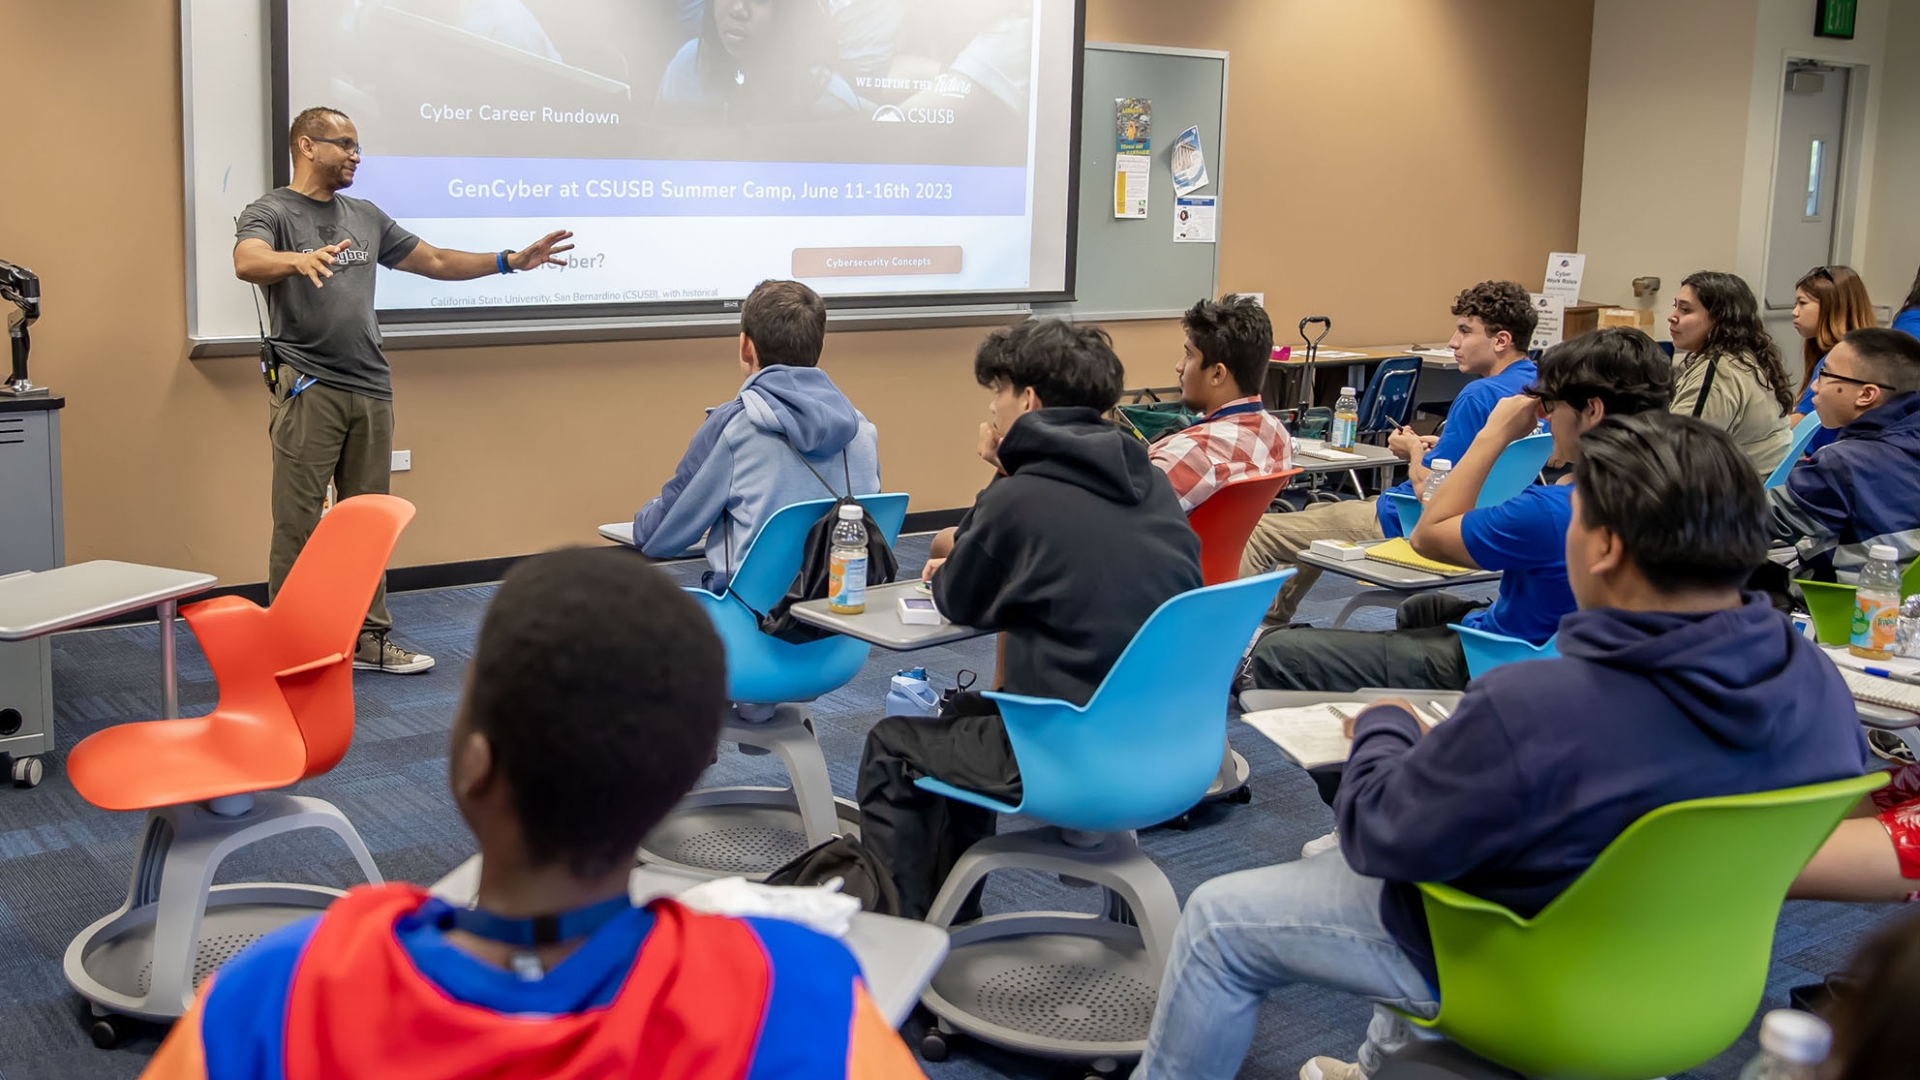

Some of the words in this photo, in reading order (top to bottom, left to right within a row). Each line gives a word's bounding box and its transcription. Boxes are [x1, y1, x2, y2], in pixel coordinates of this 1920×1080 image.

[856, 77, 872, 87] WE
[874, 78, 910, 89] DEFINE
[913, 79, 932, 90] THE
[420, 103, 472, 123] Cyber
[479, 105, 536, 122] Career
[542, 107, 619, 124] Rundown
[908, 108, 954, 124] CSUSB
[448, 179, 553, 201] GenCyber
[559, 180, 579, 198] at
[585, 180, 654, 198] CSUSB
[661, 180, 737, 199] Summer
[743, 181, 796, 201] Camp,
[801, 182, 839, 199] June
[845, 183, 910, 199] 11-16th
[915, 183, 953, 200] 2023
[826, 257, 889, 269] Cybersecurity
[892, 256, 931, 268] Concepts
[431, 297, 476, 307] California
[478, 295, 502, 305] State
[554, 292, 572, 303] San
[573, 290, 620, 302] Bernardino
[662, 288, 681, 299] with
[682, 287, 718, 298] historical
